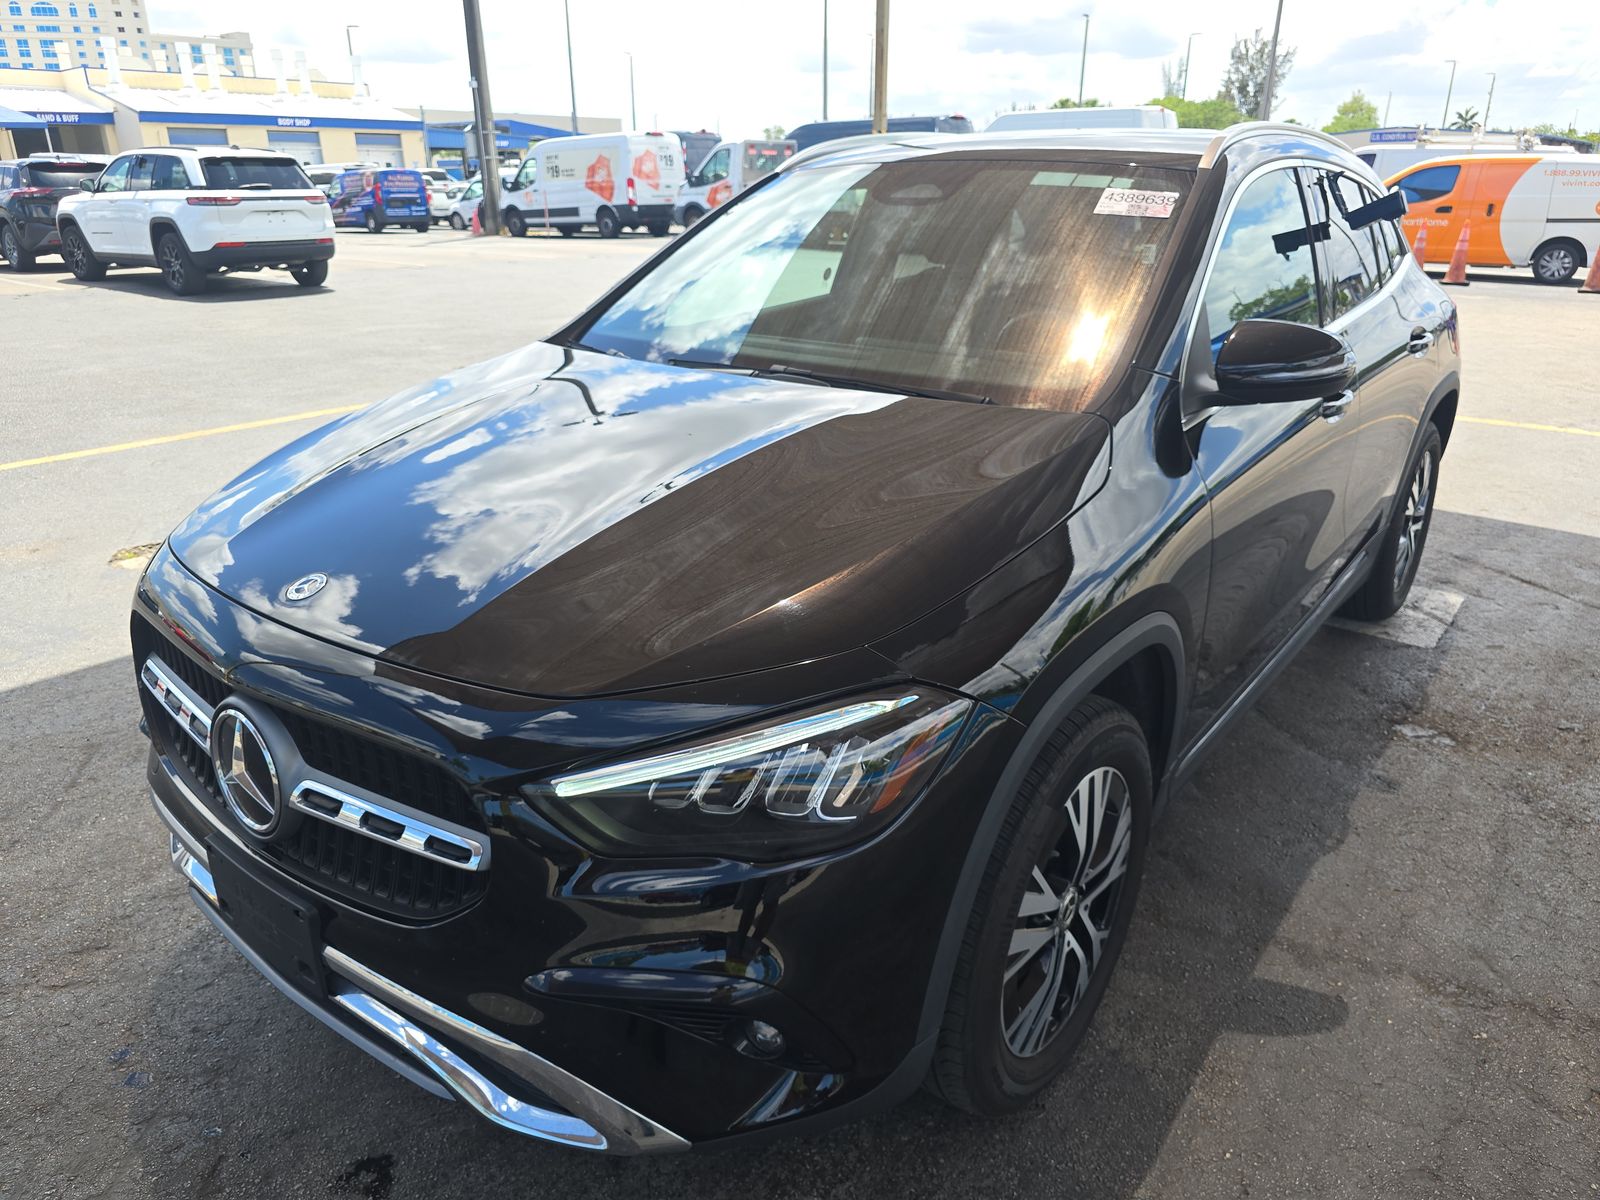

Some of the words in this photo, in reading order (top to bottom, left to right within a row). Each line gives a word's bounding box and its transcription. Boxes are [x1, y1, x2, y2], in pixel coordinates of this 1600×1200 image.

[36, 113, 55, 122] SAND
[55, 114, 62, 122] &
[62, 114, 79, 122] BUFF
[277, 117, 294, 126] BODY
[294, 118, 312, 127] SHOP
[1104, 192, 1177, 206] 4389639
